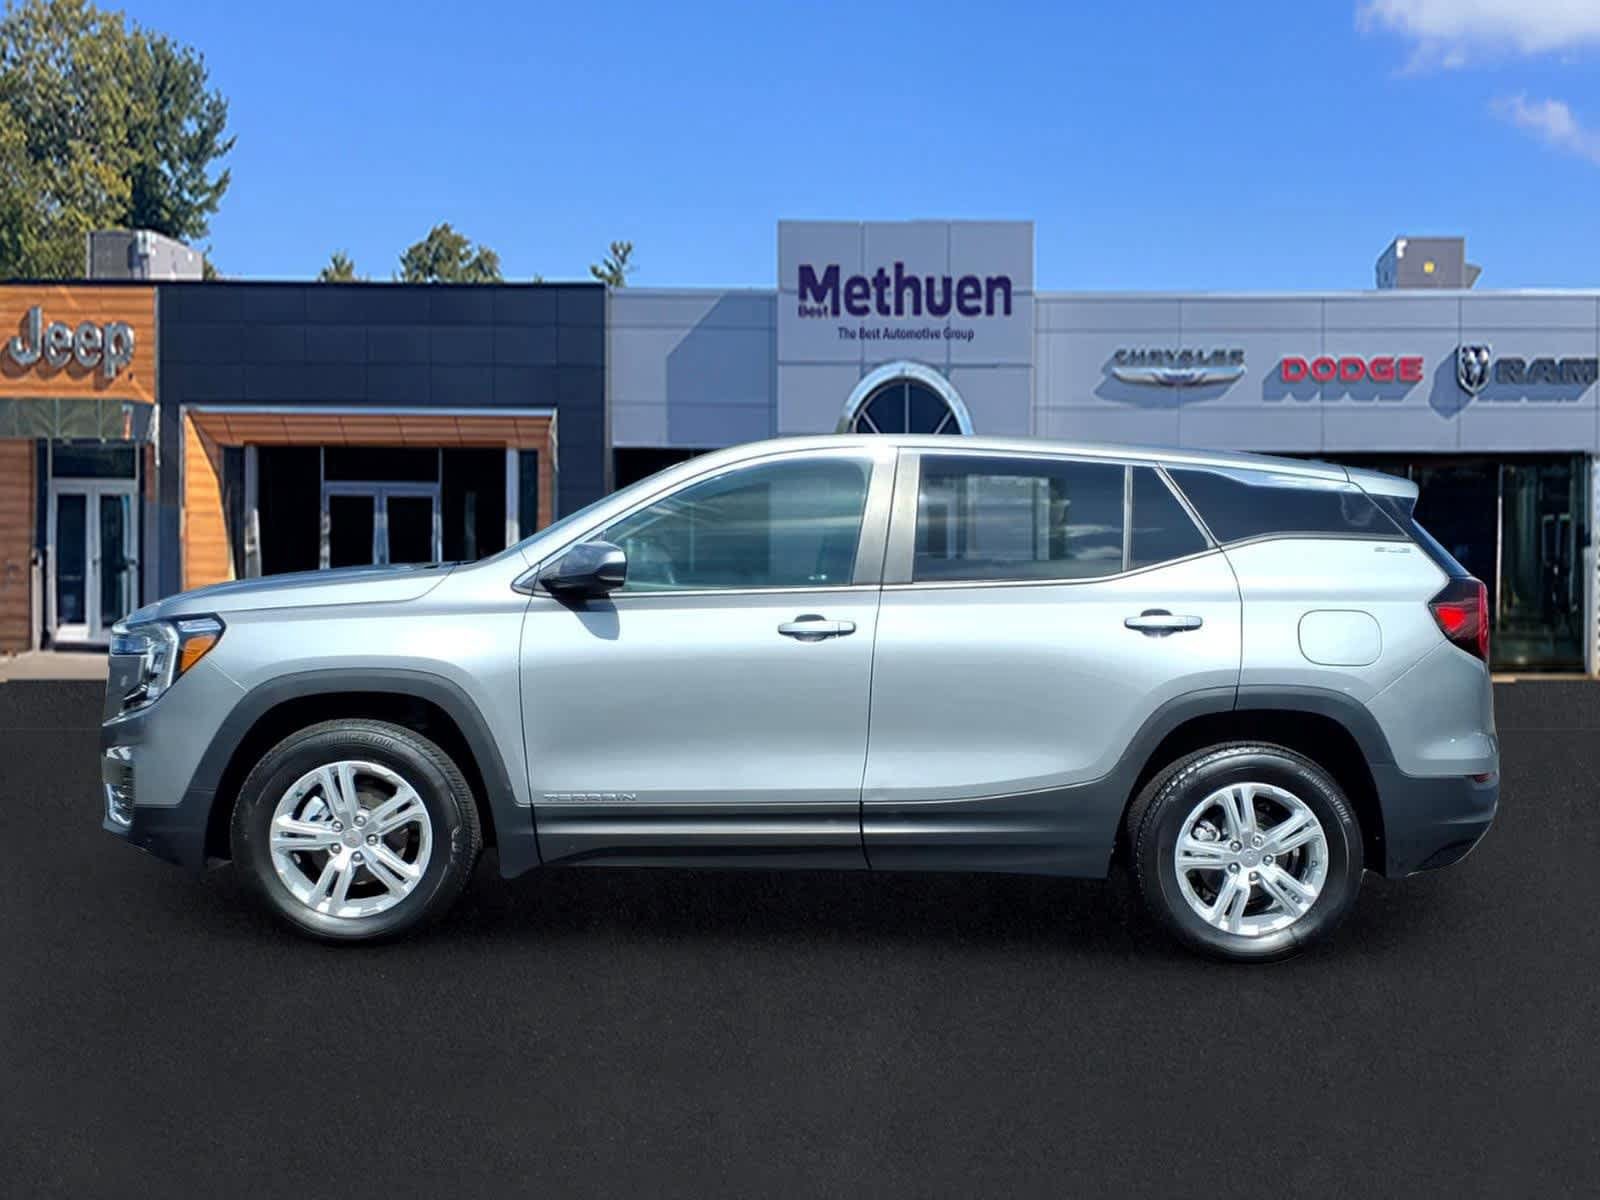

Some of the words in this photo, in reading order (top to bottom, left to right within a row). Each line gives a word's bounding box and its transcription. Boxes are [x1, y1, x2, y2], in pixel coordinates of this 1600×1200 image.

[798, 261, 1012, 317] Methuen
[9, 306, 135, 379] Jeep
[838, 327, 856, 339] The
[859, 327, 880, 339] Best
[883, 327, 940, 339] Automotive
[943, 327, 975, 341] Group
[1281, 357, 1423, 383] DODGE
[1495, 357, 1599, 384] RAM
